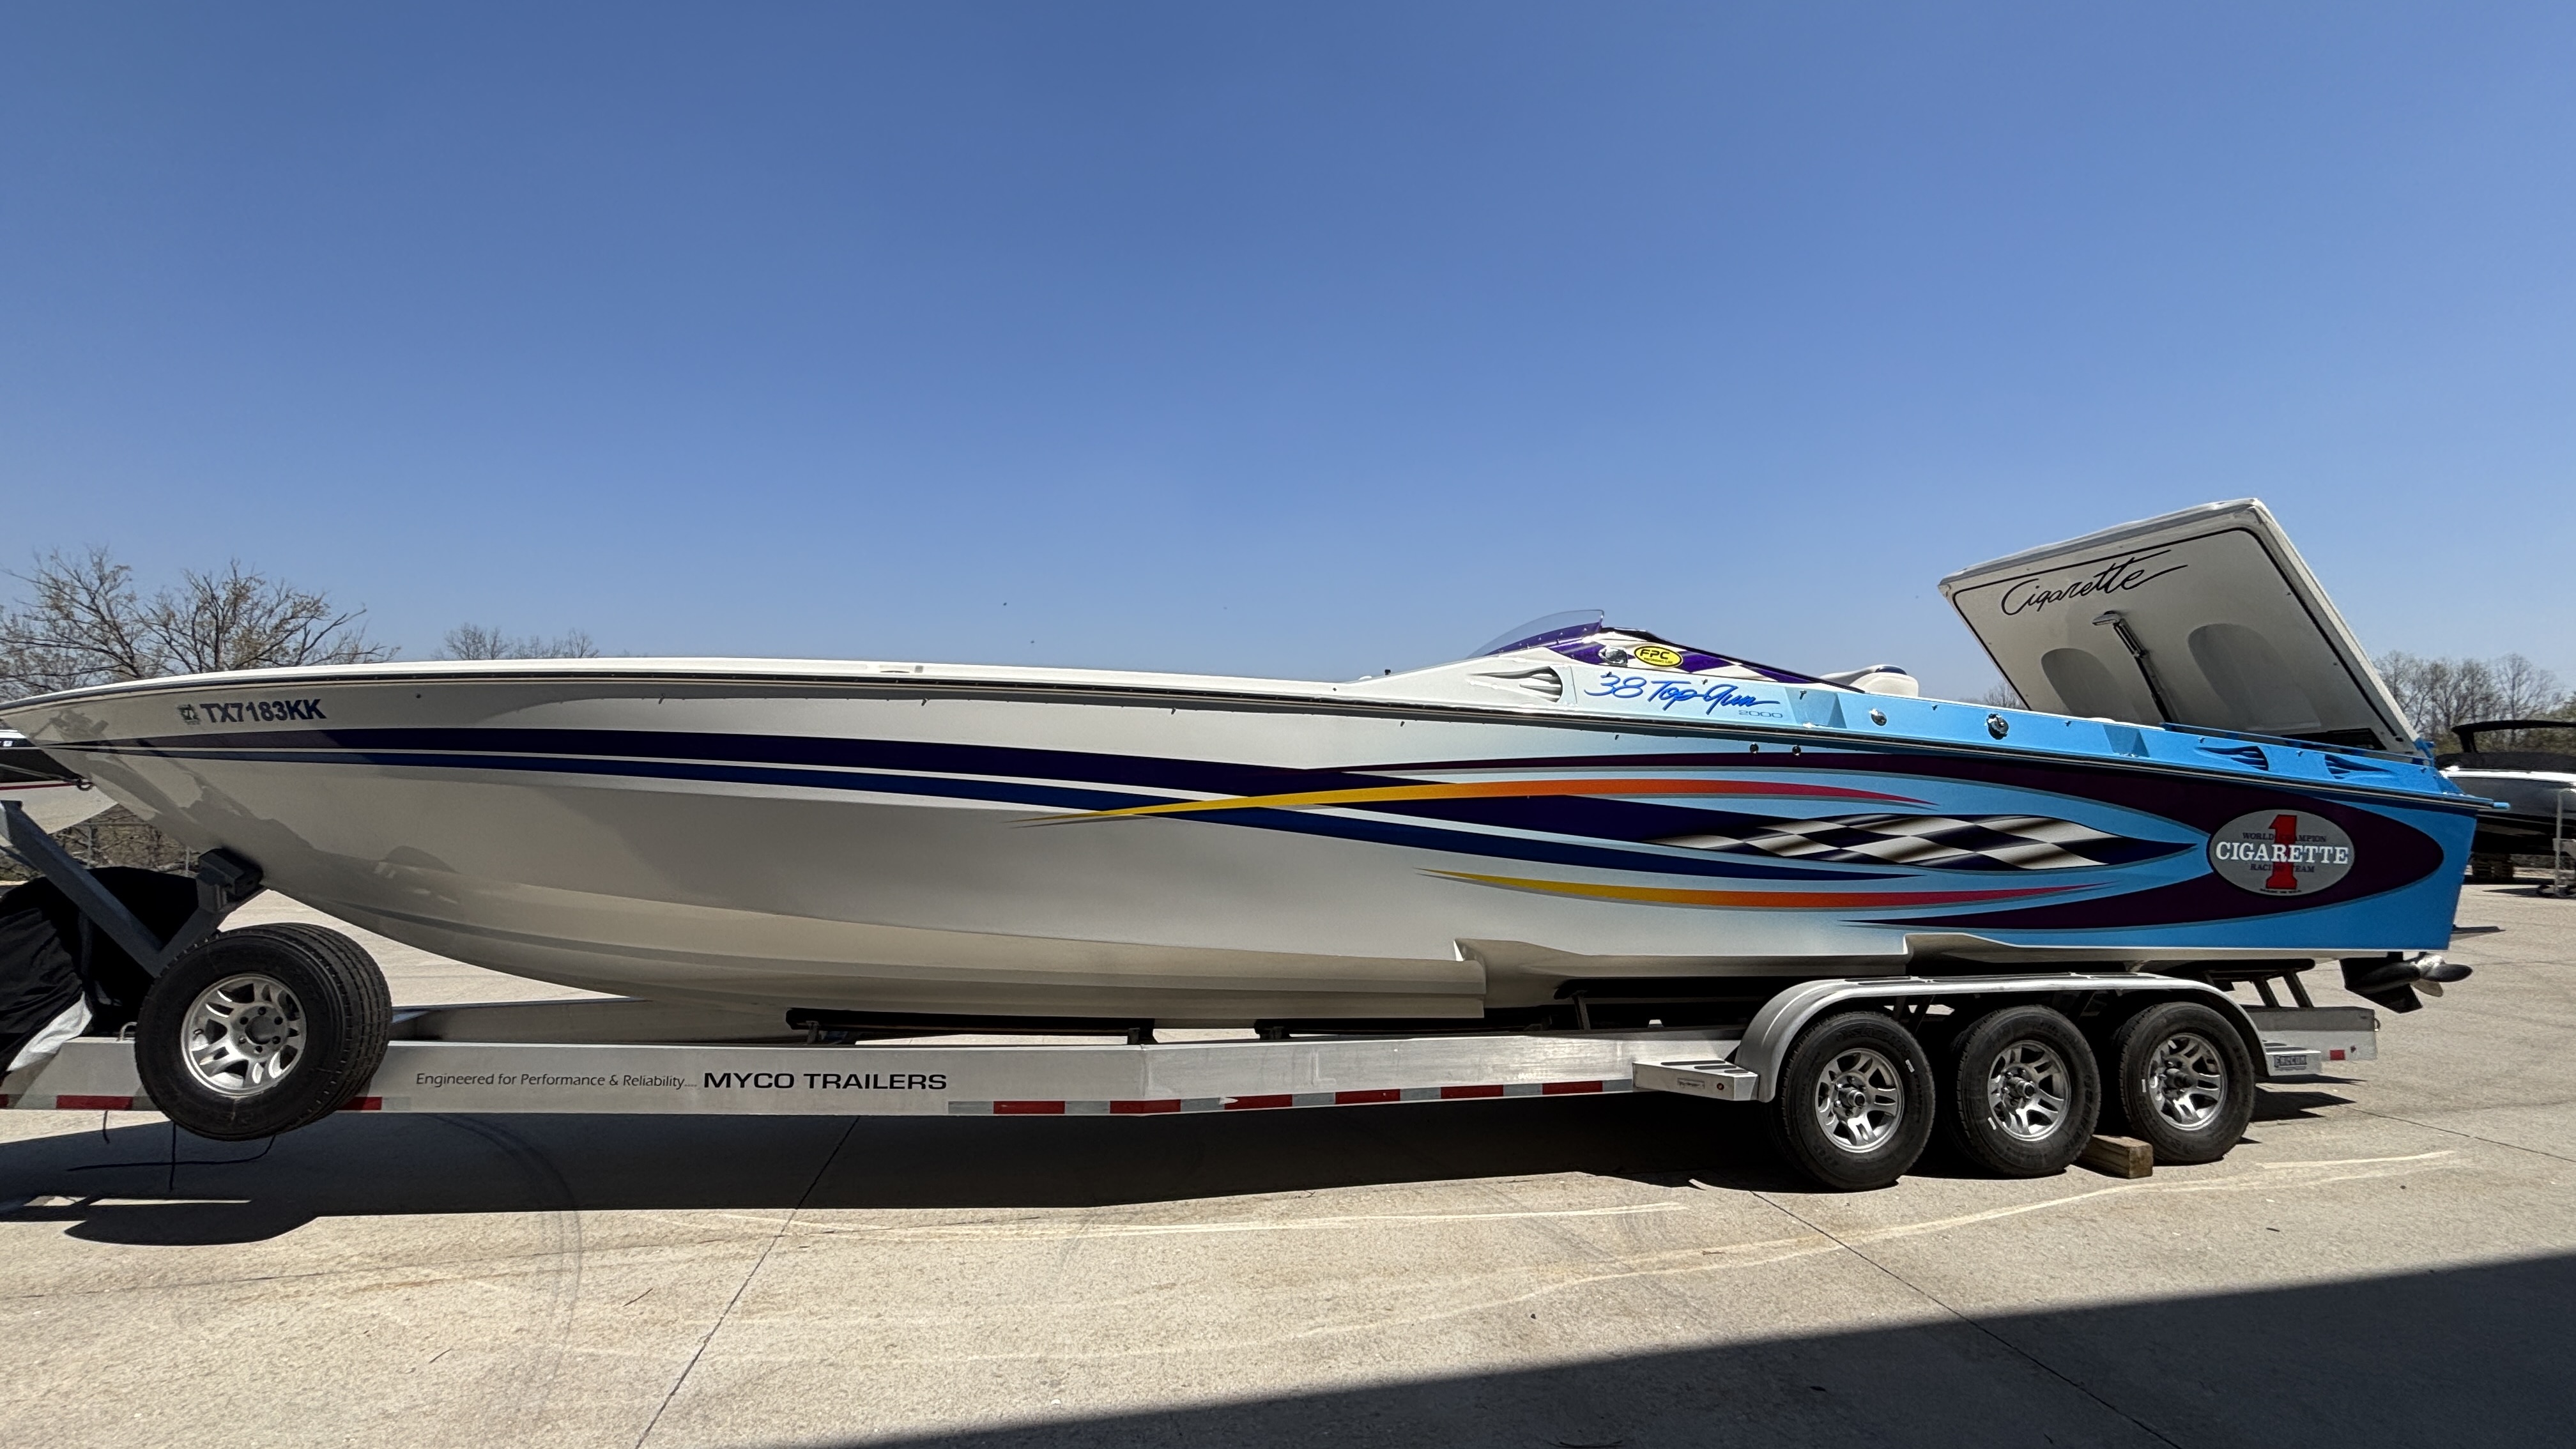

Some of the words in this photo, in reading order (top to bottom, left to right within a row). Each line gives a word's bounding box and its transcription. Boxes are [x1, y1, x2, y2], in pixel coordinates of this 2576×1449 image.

[2000, 549, 2188, 616] Cigarette
[1639, 648, 1671, 660] FPC
[1584, 673, 1647, 698] 38
[199, 699, 327, 723] TX7183KK
[1738, 710, 1783, 719] 2000
[2242, 832, 2274, 841] WORLD
[2216, 841, 2349, 864] CIGARETTE
[2266, 814, 2297, 889] 1
[2250, 863, 2285, 871] RACI
[416, 1073, 494, 1087] Engineered
[498, 1074, 517, 1085] for
[521, 1074, 605, 1085] Performance
[609, 1075, 618, 1086] &
[704, 1073, 795, 1089] MYCO
[803, 1073, 947, 1090] TRAILERS
